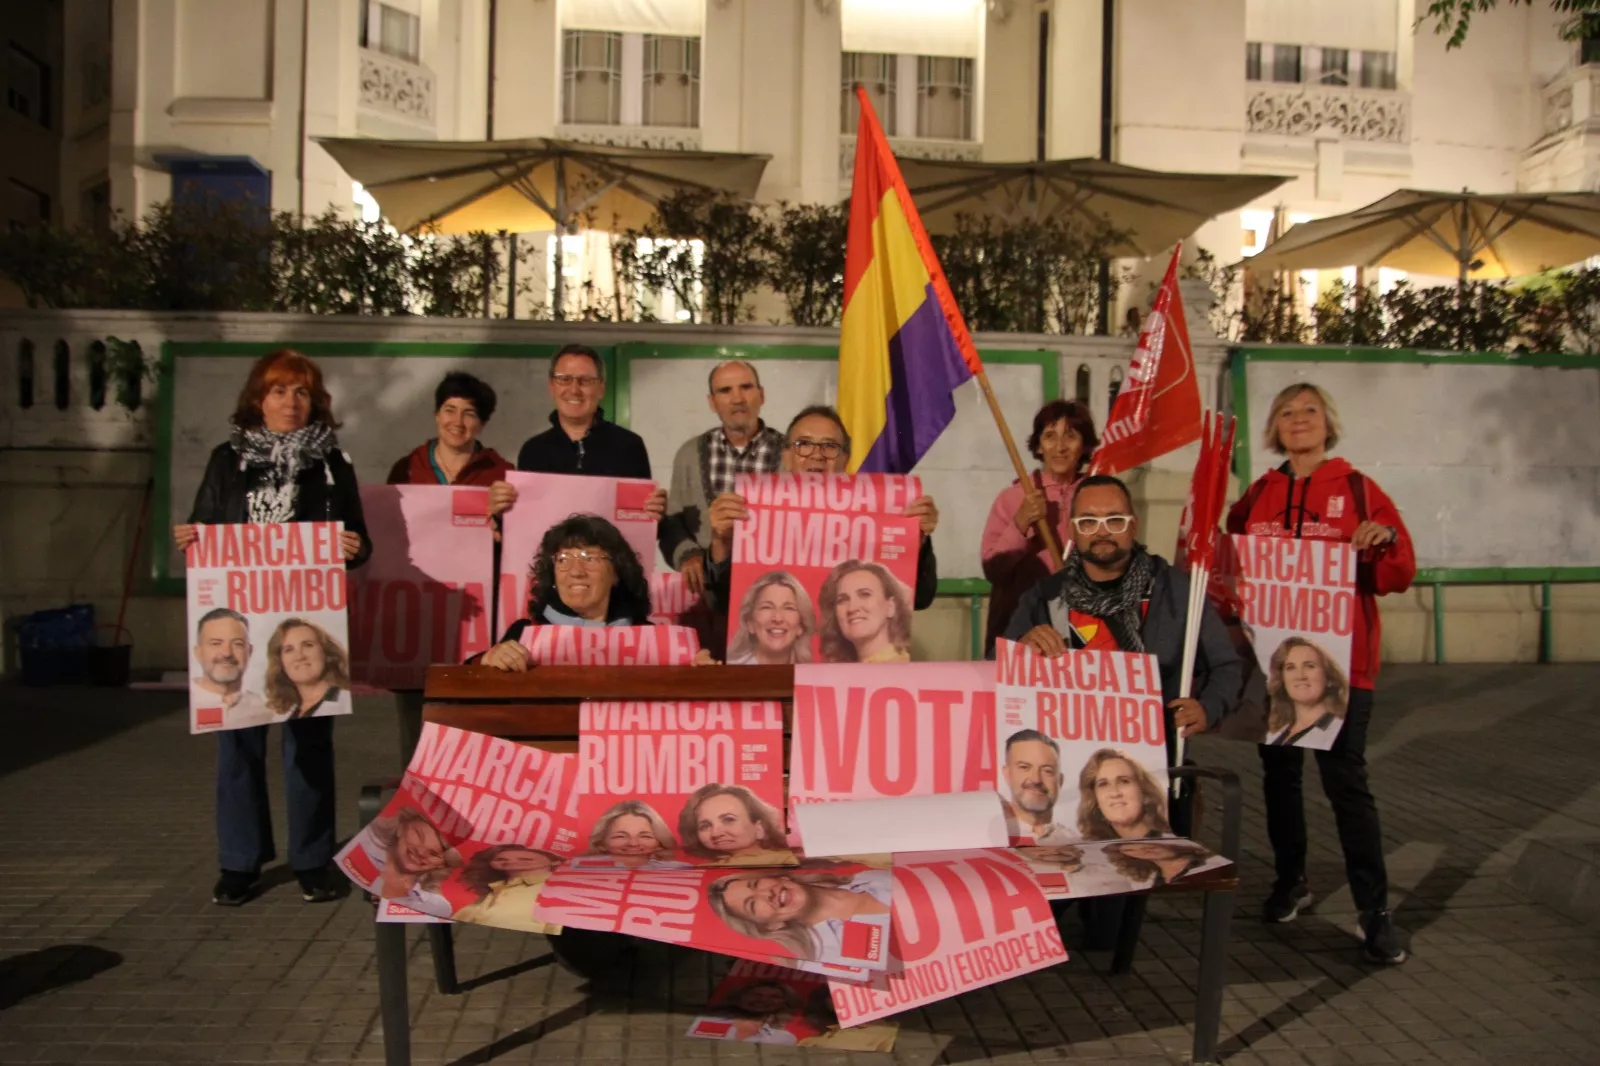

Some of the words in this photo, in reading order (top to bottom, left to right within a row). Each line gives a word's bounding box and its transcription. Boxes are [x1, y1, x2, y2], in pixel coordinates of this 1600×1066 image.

[735, 472, 877, 513] MARCA
[187, 522, 307, 568] MARCA
[313, 520, 346, 565] EL
[732, 509, 876, 567] RUMBO
[1322, 542, 1356, 589] EL
[227, 568, 347, 614] RUMBO
[1236, 580, 1352, 637] RUMBO
[523, 626, 663, 665] MARCA
[996, 640, 1120, 693] MARCA
[1126, 652, 1163, 697] EL
[579, 701, 735, 731] MARCA
[741, 701, 783, 730] EL
[815, 686, 998, 796] VOTA
[1036, 691, 1166, 746] RUMBO
[407, 721, 574, 811] MARCA
[579, 733, 735, 795] RUMBO
[401, 774, 552, 850] RUMBO
[832, 988, 851, 1021] 9
[852, 980, 883, 1017] DE
